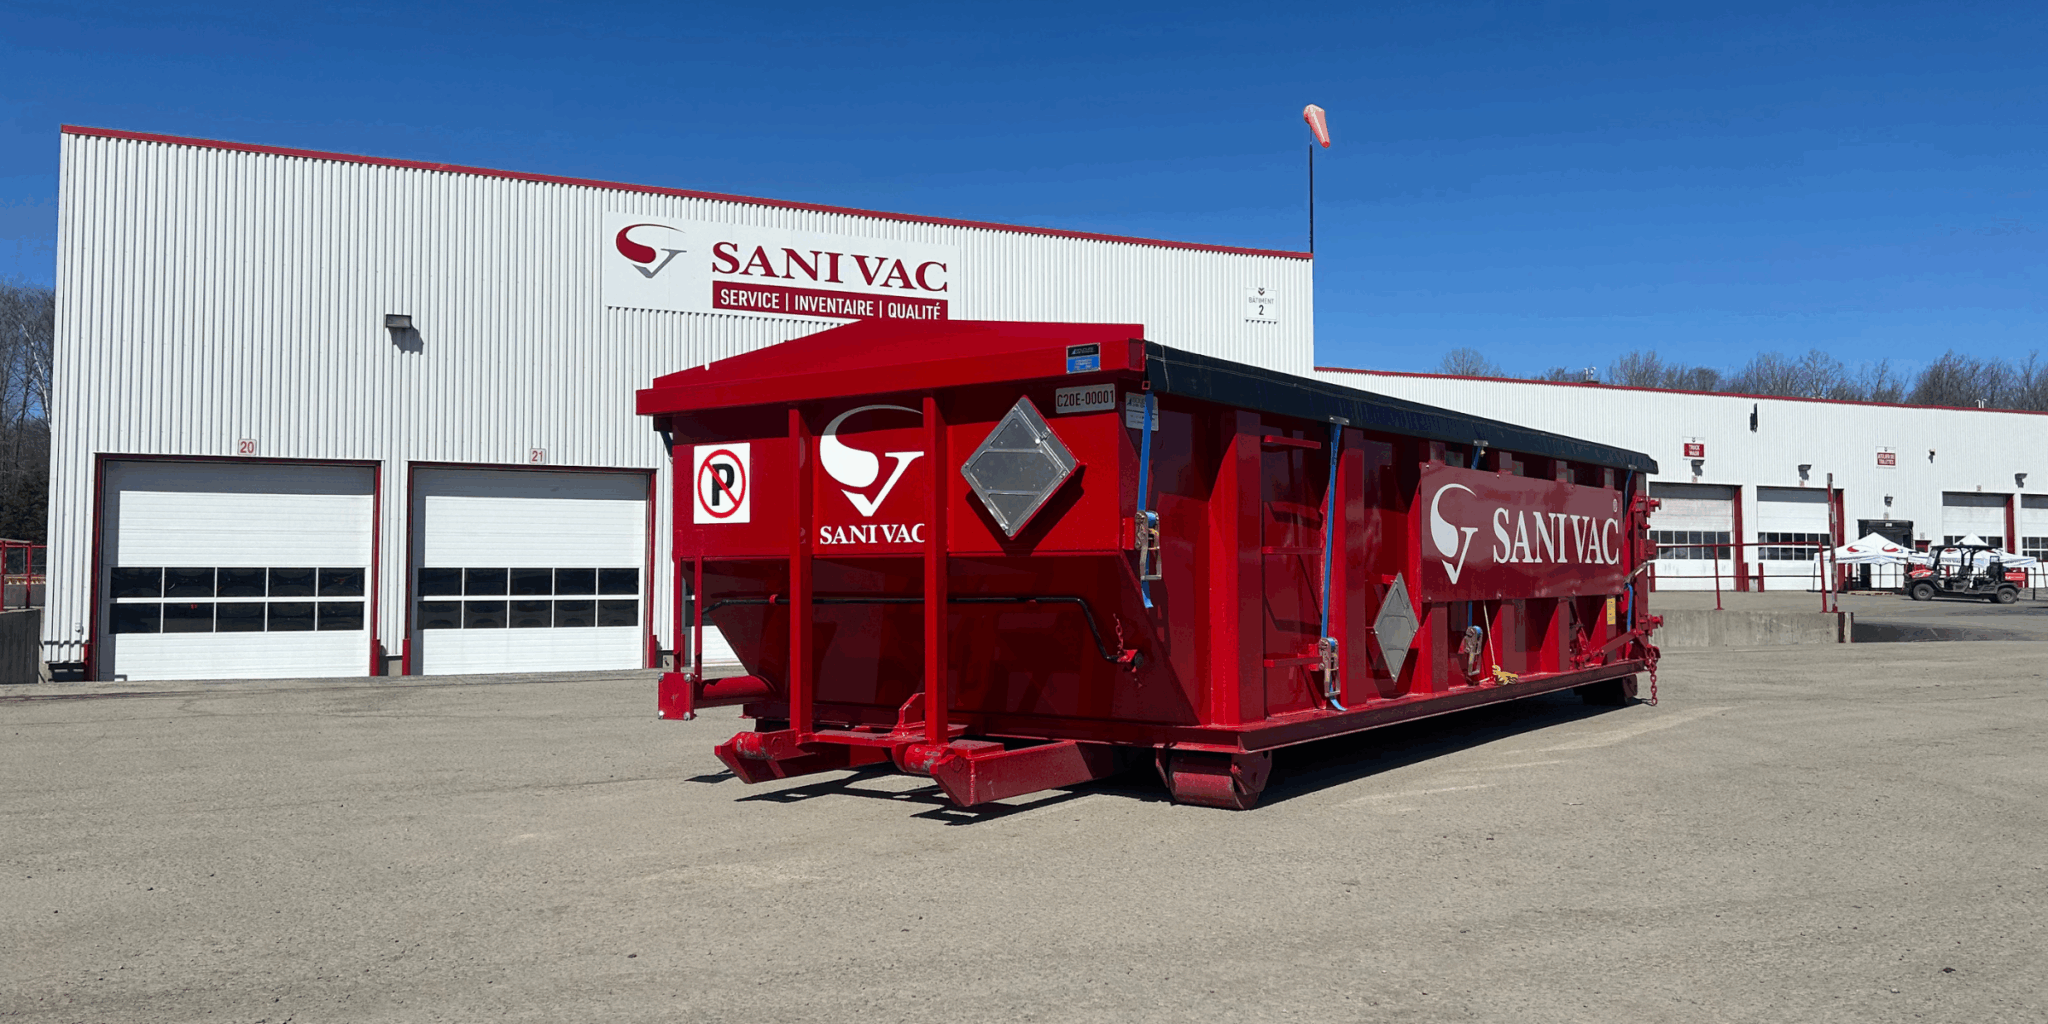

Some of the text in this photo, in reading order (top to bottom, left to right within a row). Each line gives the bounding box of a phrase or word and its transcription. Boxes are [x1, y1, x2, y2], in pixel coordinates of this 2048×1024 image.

[712, 241, 948, 293] SANI VAC
[720, 288, 941, 320] SERVICE INVENTAIRE QUALITÉ
[1258, 304, 1265, 315] 2
[1056, 389, 1115, 408] C20E-00001
[240, 441, 254, 453] 20
[531, 450, 543, 462] 21
[819, 523, 925, 545] SANI VAC
[1493, 507, 1620, 565] SANI VAC
